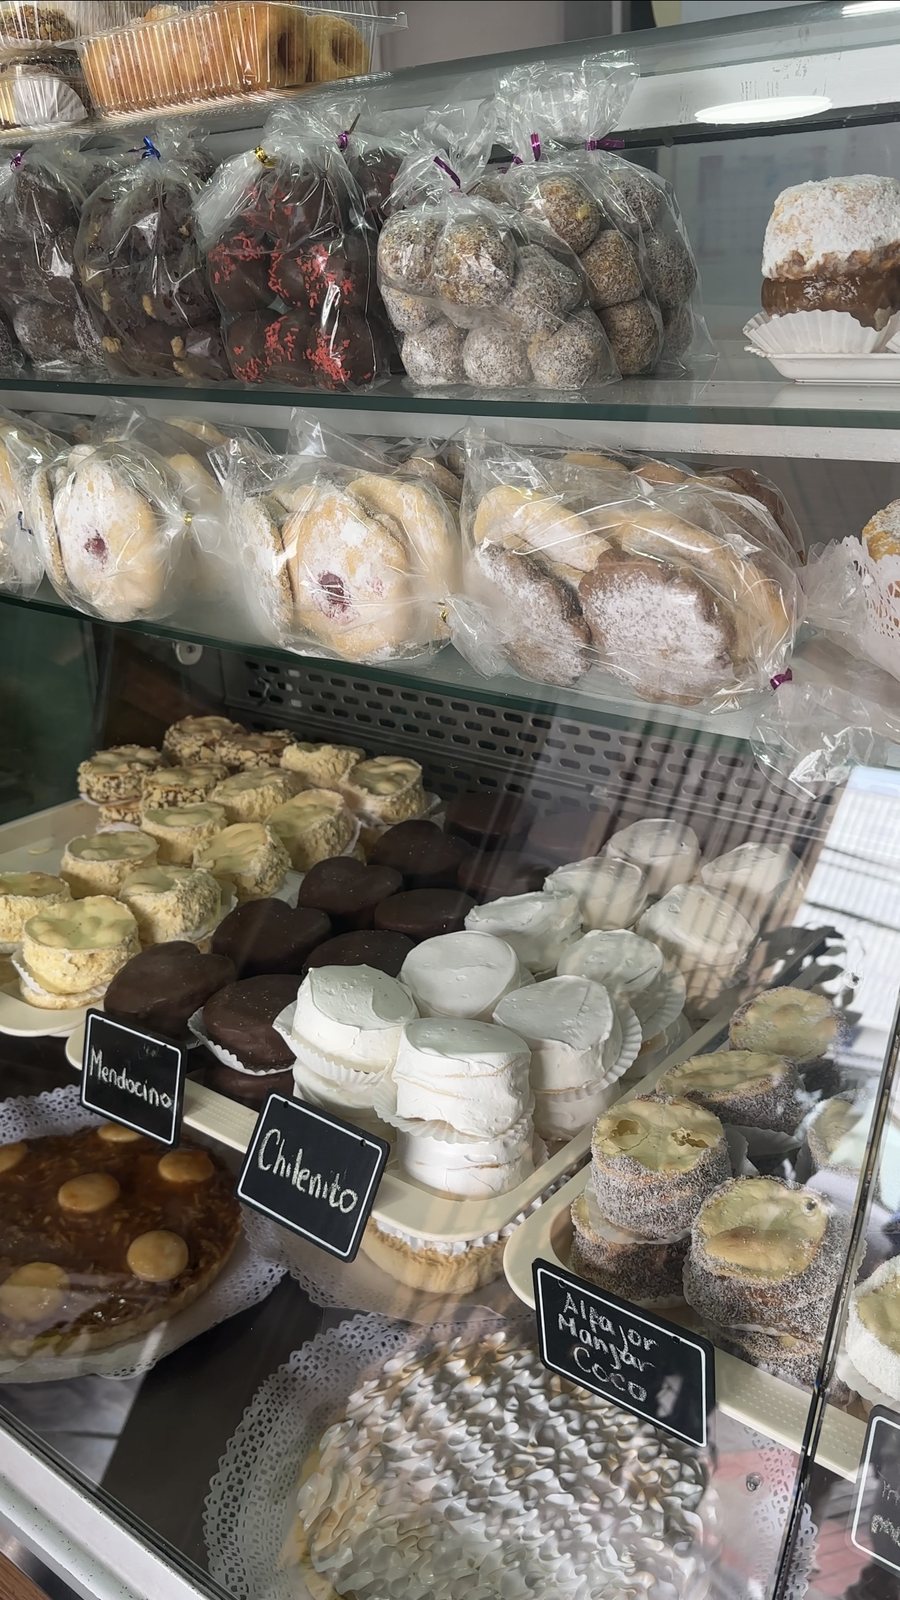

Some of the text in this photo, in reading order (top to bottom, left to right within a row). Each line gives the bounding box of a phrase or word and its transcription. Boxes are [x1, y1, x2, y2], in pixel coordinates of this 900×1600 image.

[89, 1046, 172, 1108] Mendocino
[258, 1129, 358, 1213] Chilenito
[573, 1346, 648, 1402] Coco
